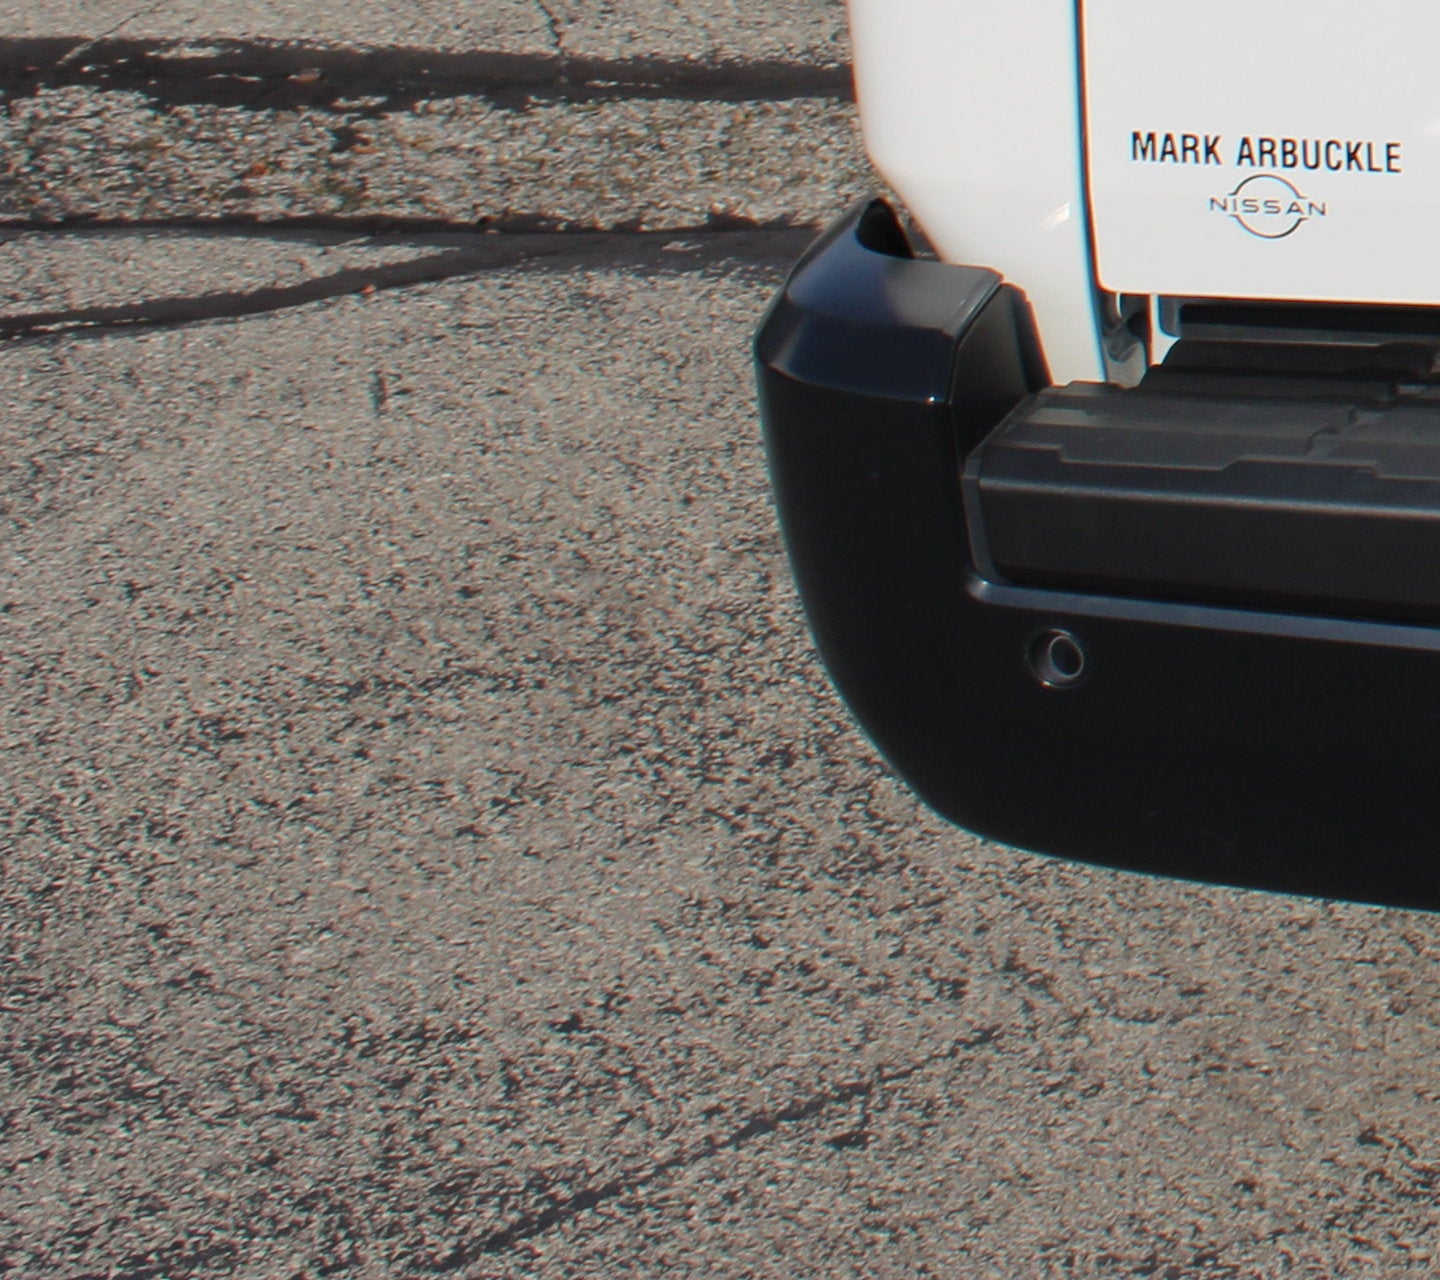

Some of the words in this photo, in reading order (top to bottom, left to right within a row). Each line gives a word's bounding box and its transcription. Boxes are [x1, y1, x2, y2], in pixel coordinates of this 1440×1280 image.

[1131, 130, 1222, 166] MARK
[1236, 135, 1402, 174] ARBUCKLE
[1208, 196, 1328, 217] NISSAN
